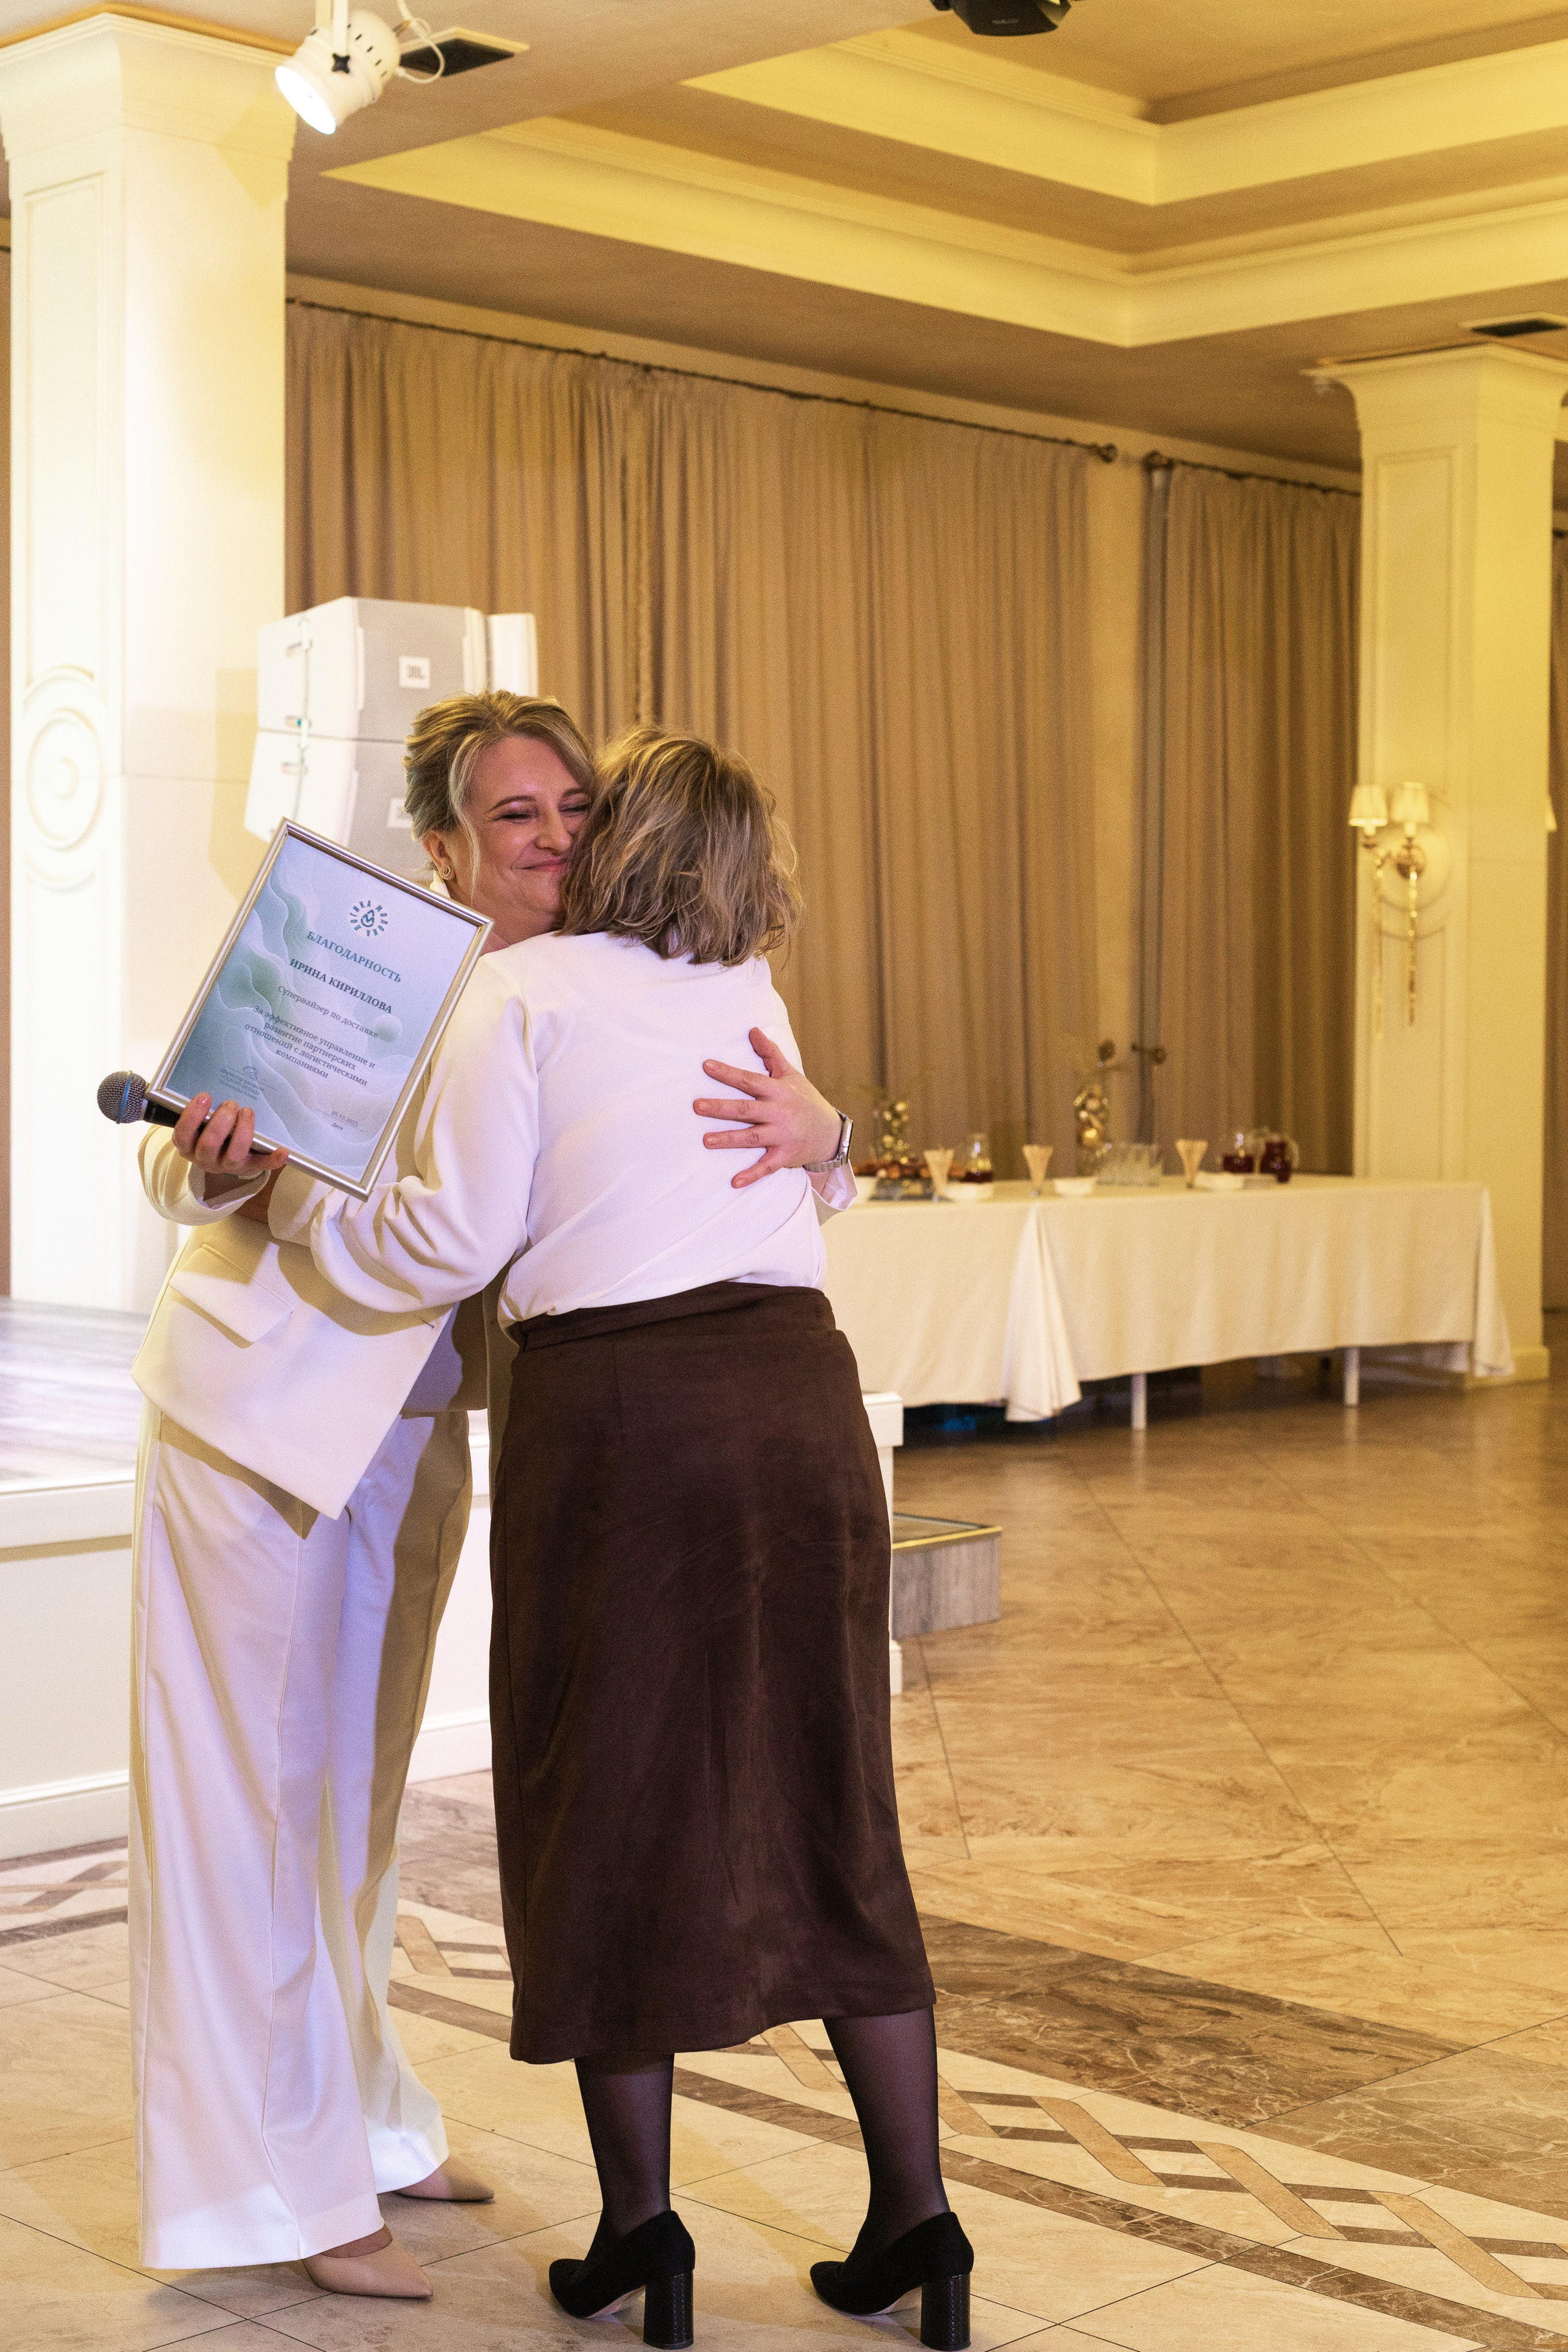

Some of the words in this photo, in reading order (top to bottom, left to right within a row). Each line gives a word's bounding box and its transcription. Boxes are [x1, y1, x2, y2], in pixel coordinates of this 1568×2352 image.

[407, 665, 424, 679] JBL
[306, 930, 403, 983] БЛАГОДАРНОСТЬ
[277, 985, 330, 1016] Супервайзер
[330, 1011, 341, 1020] по
[341, 1017, 379, 1038] доставке
[289, 958, 328, 982] ИРИНА
[328, 977, 394, 1014] КИРИЛЛОВА
[244, 1023, 293, 1050] отношений
[298, 1050, 368, 1086] логистическими
[253, 1005, 265, 1014] За
[263, 1011, 318, 1041] эффективное
[318, 1038, 368, 1065] управление
[263, 1021, 303, 1044] развитие
[303, 1040, 356, 1070] партнерских
[275, 1048, 329, 1078] компаниями
